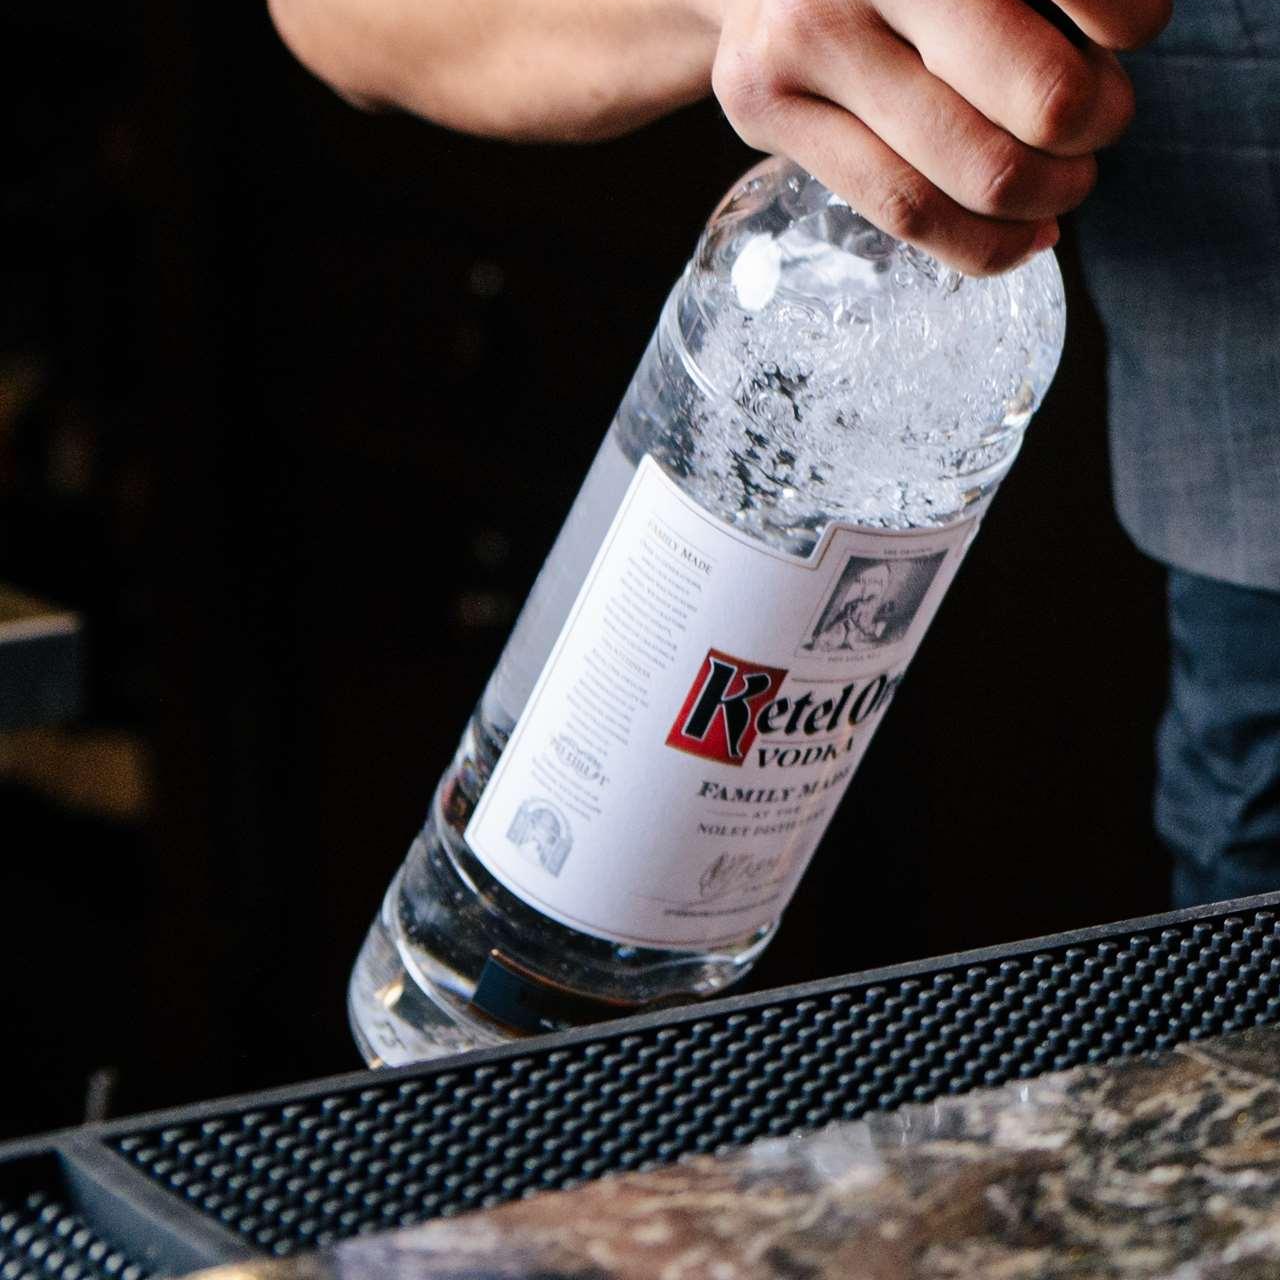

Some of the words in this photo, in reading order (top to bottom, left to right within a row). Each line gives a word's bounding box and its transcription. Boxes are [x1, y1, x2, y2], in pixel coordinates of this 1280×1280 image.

[680, 547, 712, 576] MADE
[681, 657, 855, 758] Ketel
[697, 780, 795, 803] FAMILY
[696, 822, 749, 837] NOLET
